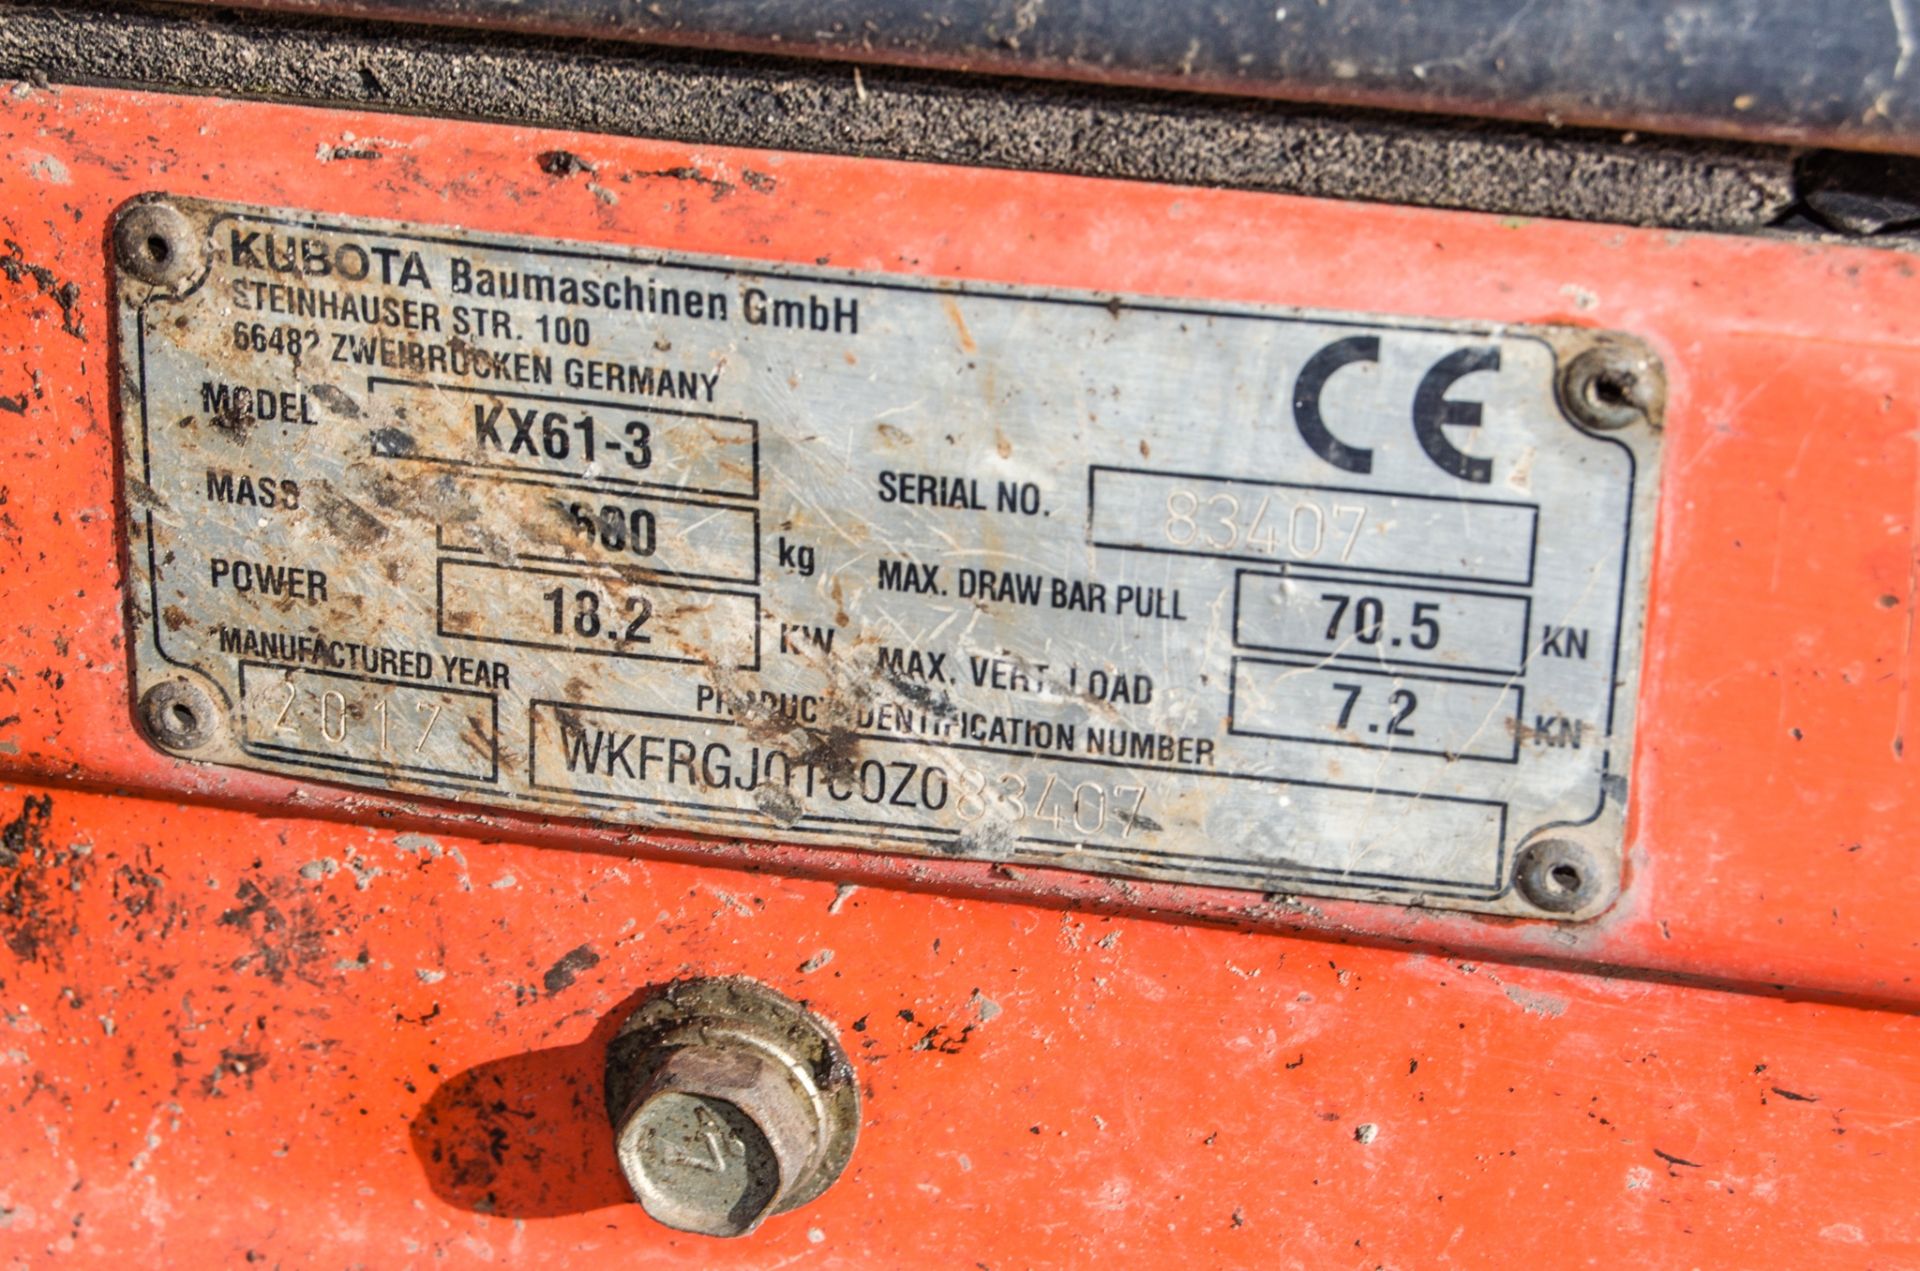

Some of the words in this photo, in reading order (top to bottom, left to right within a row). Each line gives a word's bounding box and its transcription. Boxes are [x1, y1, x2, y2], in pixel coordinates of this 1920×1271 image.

[230, 228, 432, 290] KUBOTA
[450, 257, 728, 321] Baumaschinen
[743, 288, 859, 334] GmbH
[232, 278, 441, 333] STEINHAUSER
[452, 305, 523, 341] STR.
[536, 314, 590, 347] 100
[201, 381, 318, 426] MODEL
[564, 357, 719, 402] GERMANY
[475, 404, 652, 469] KX61-3
[1293, 335, 1501, 484] CE
[206, 470, 299, 510] MASS
[878, 470, 987, 511] SERIAL
[997, 482, 1050, 517] NO.
[1164, 490, 1367, 562] 83407
[211, 558, 328, 601] POWER
[778, 536, 815, 576] kg
[543, 586, 652, 644] 18.2
[878, 560, 948, 597] MAX.
[958, 568, 1042, 606] DRAW
[1050, 577, 1107, 614] BAR
[1116, 585, 1188, 621] PULL
[780, 622, 835, 656] KW
[1321, 593, 1441, 650] 70.5
[1541, 625, 1589, 660] KN
[219, 626, 433, 680] MANUFACTURED
[442, 654, 511, 690] YEAR
[878, 646, 956, 686] MAX.
[273, 680, 442, 753] 2017
[696, 684, 832, 724] PRDUC
[1087, 727, 1215, 766] NUMBER
[1332, 682, 1419, 738] 7.2
[1534, 714, 1582, 750] KN
